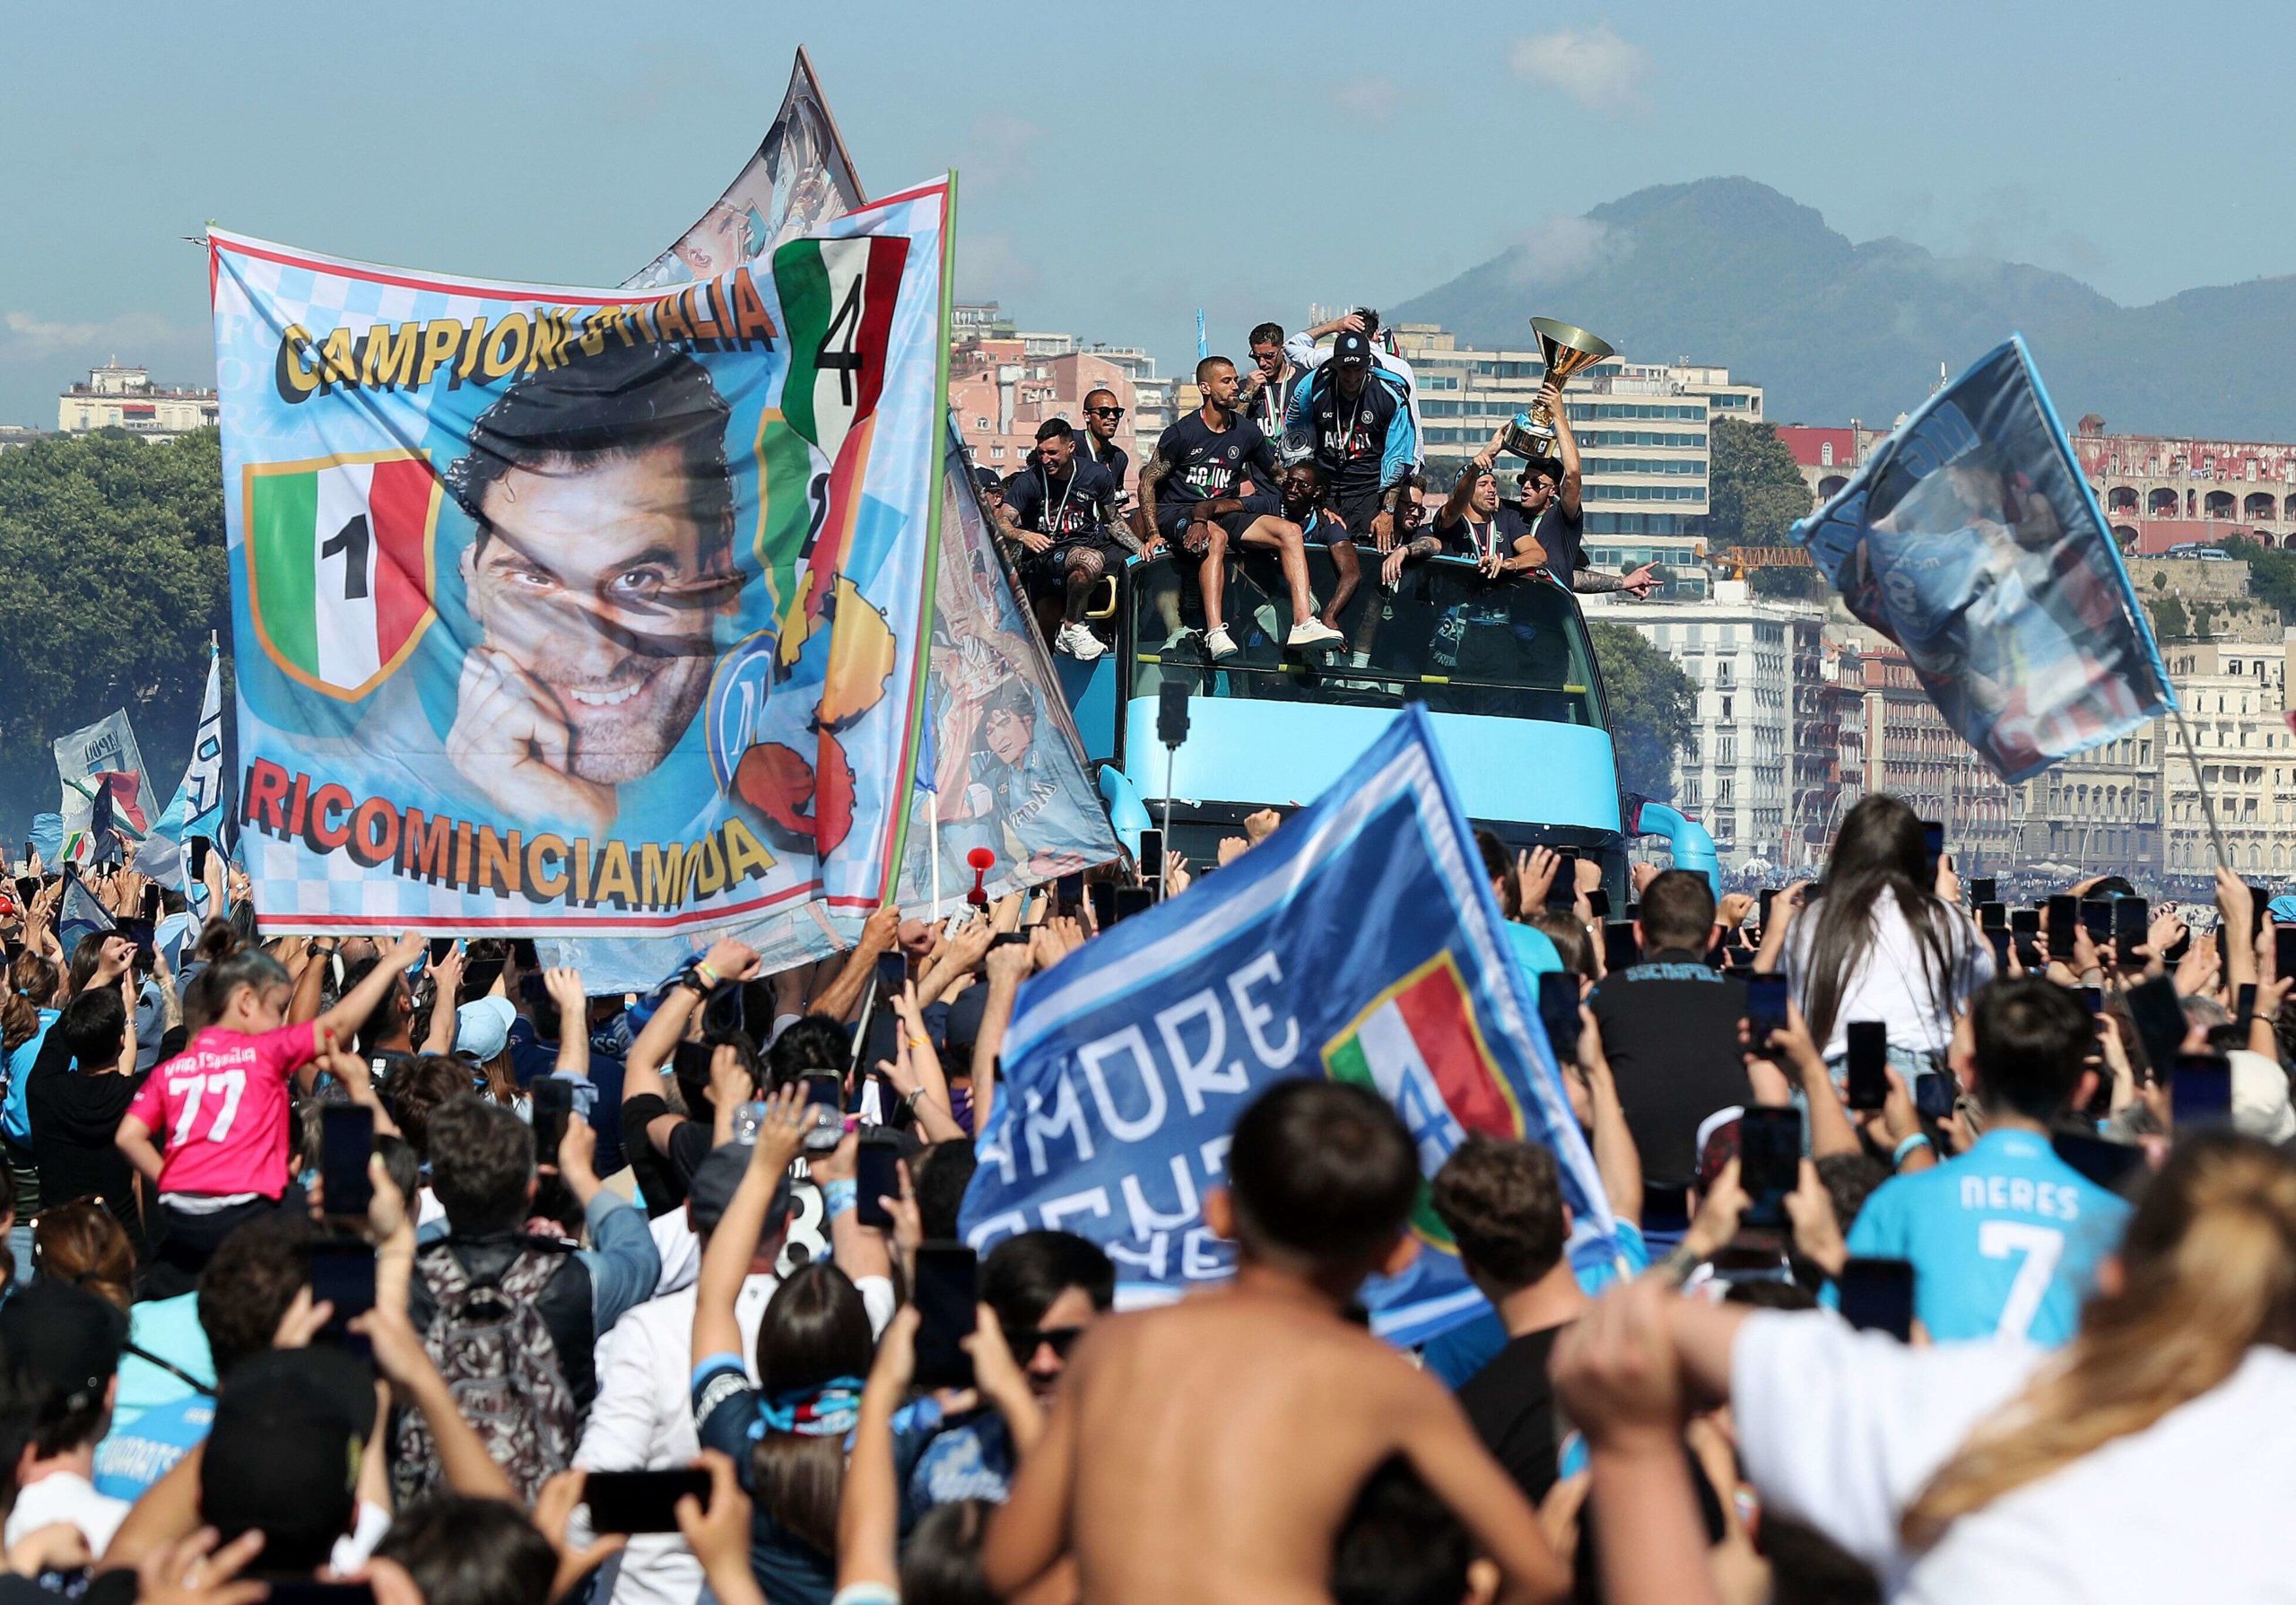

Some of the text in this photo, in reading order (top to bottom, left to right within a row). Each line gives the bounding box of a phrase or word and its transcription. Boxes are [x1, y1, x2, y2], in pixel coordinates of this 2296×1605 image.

[279, 306, 579, 400] CAMPIONI
[814, 274, 864, 406] 4
[321, 514, 370, 600] 1
[168, 1069, 248, 1147] 77
[1961, 1174, 2079, 1222] NERES
[1979, 1219, 2065, 1343] 7
